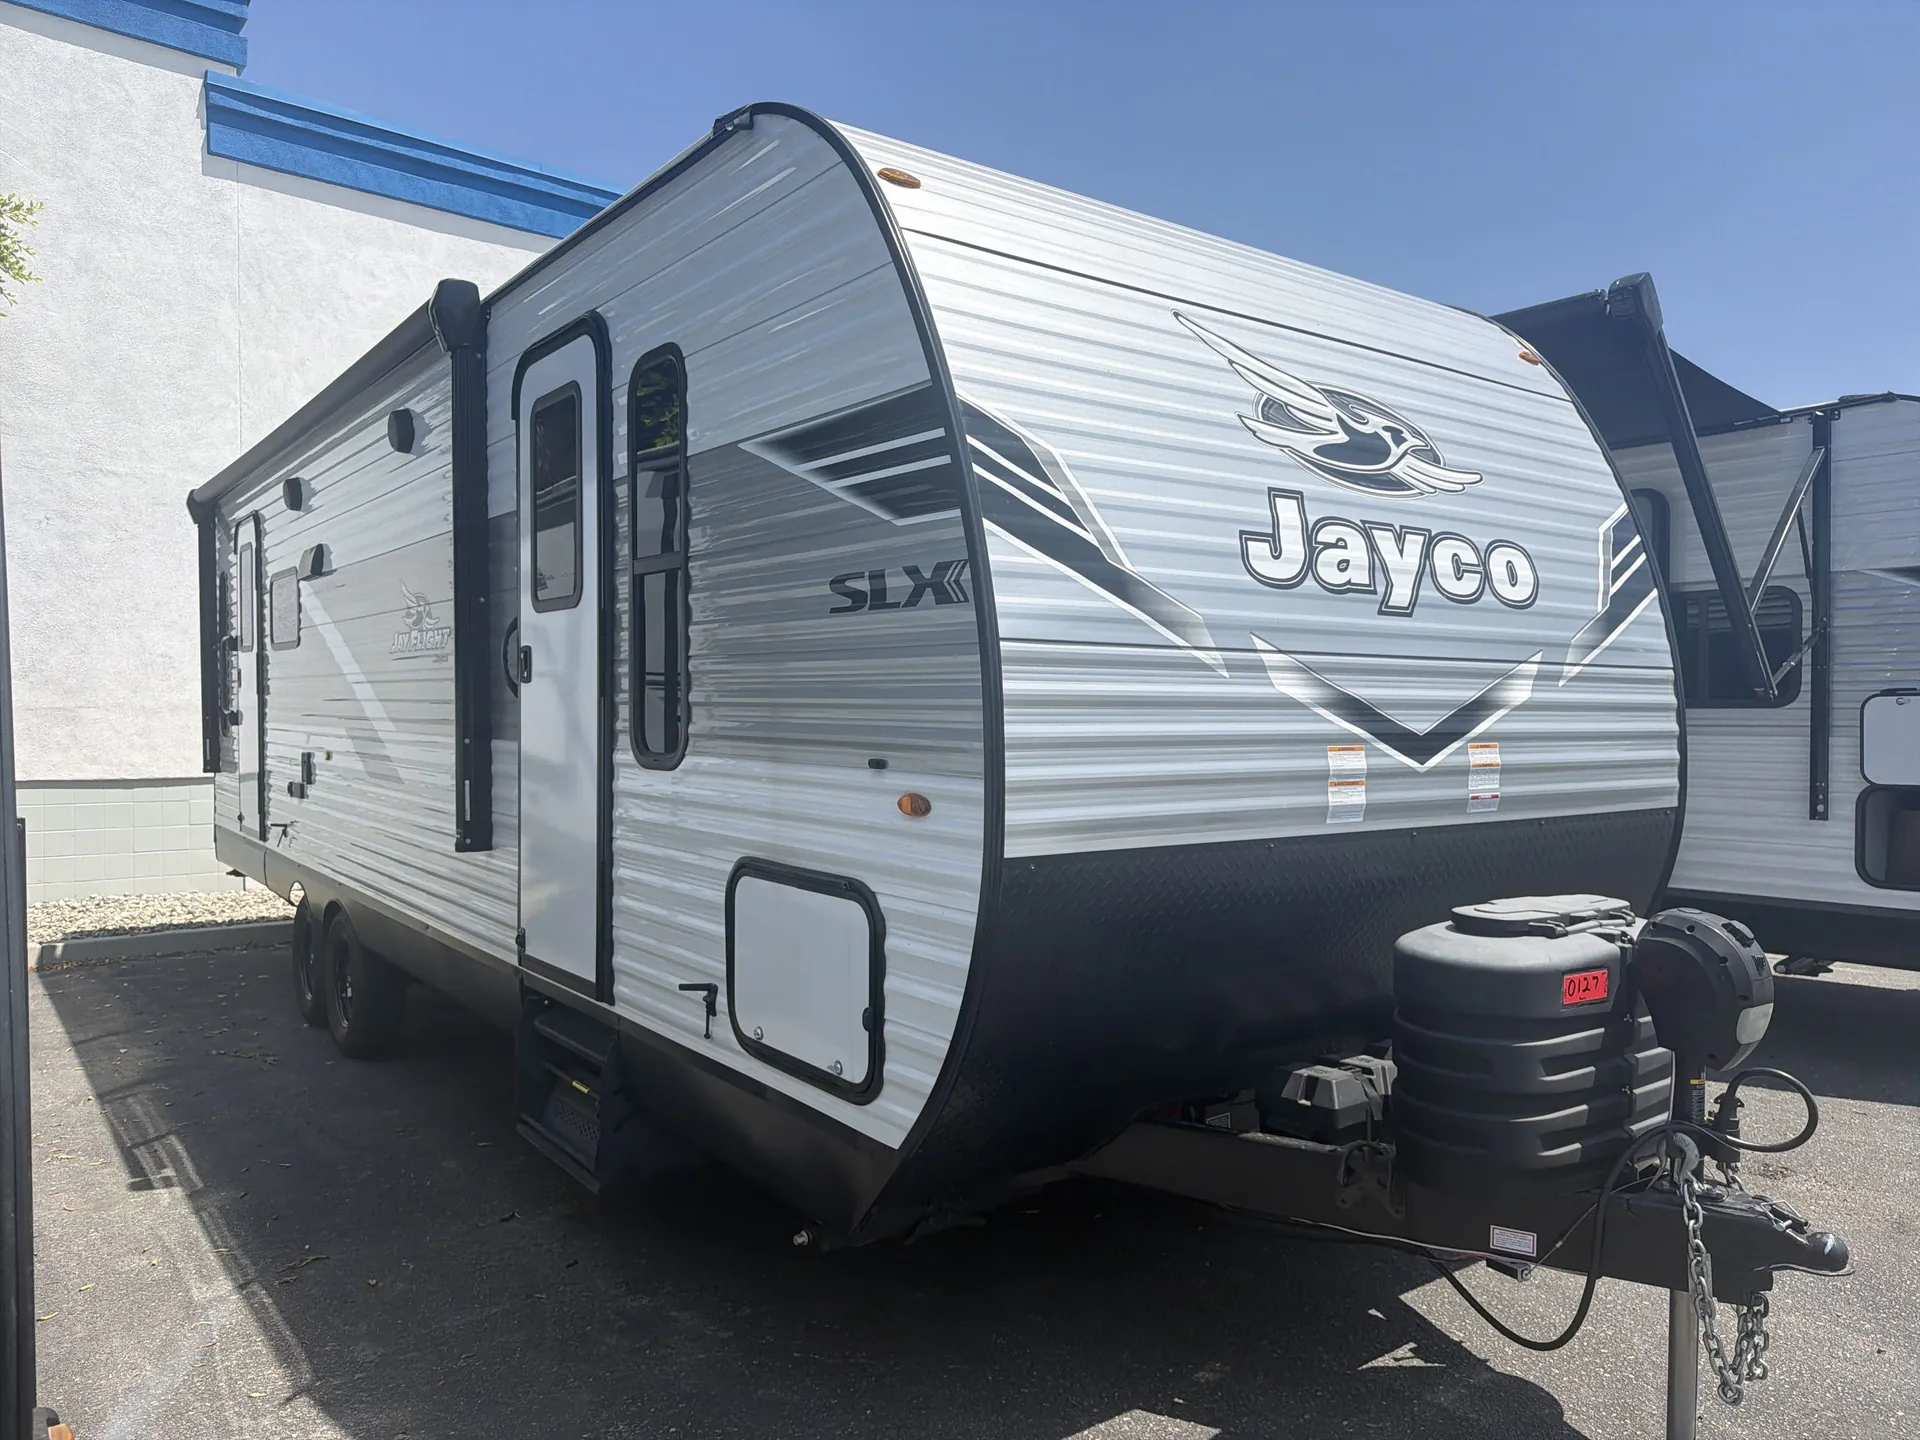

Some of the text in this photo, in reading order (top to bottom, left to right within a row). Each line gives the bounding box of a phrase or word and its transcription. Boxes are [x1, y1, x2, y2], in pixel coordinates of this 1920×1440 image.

[1239, 486, 1539, 618] Jayco
[829, 559, 965, 614] SLX
[1567, 976, 1599, 997] 0127
